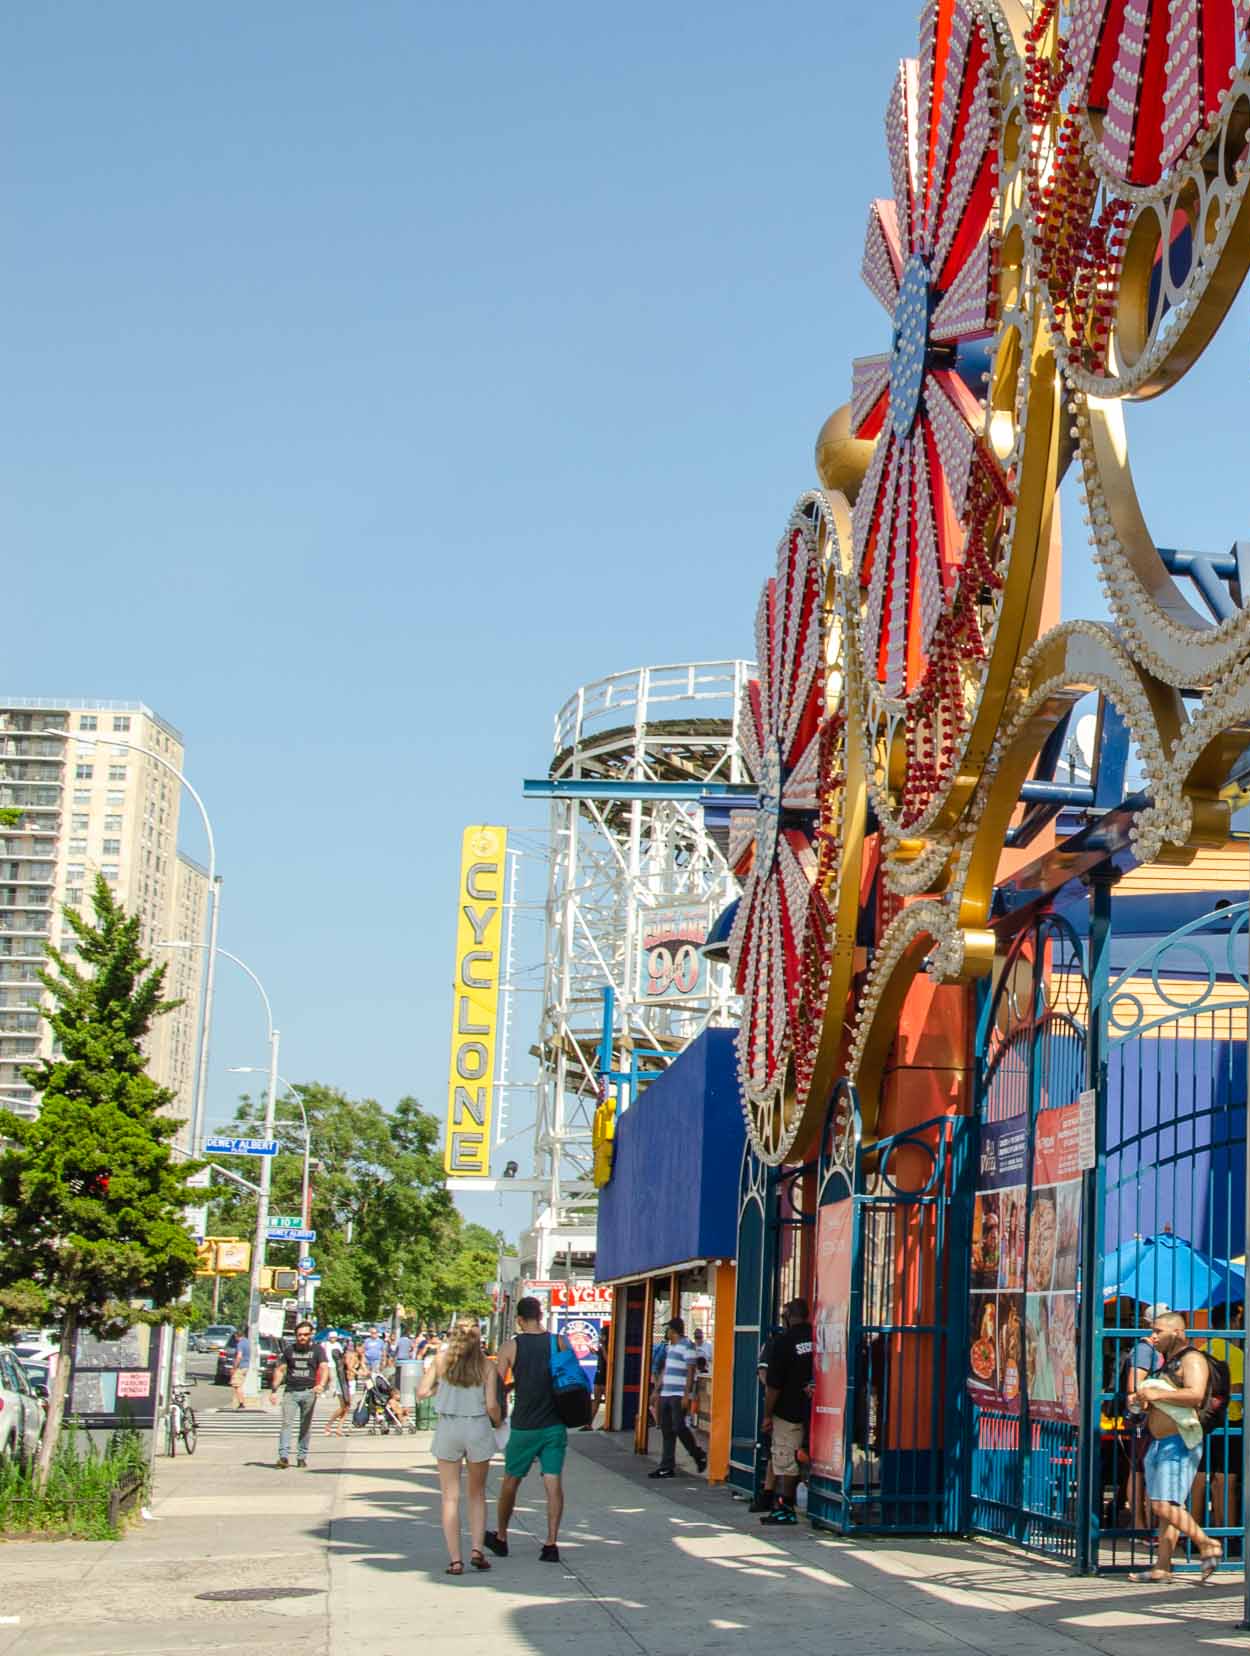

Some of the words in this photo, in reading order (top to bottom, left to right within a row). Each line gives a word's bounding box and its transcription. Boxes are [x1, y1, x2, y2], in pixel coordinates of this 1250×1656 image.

[647, 944, 699, 996] 90
[451, 862, 498, 1172] CYCLONE
[206, 1138, 238, 1149] DEWEY
[238, 1139, 275, 1151] ALBERT
[280, 1218, 291, 1227] 10
